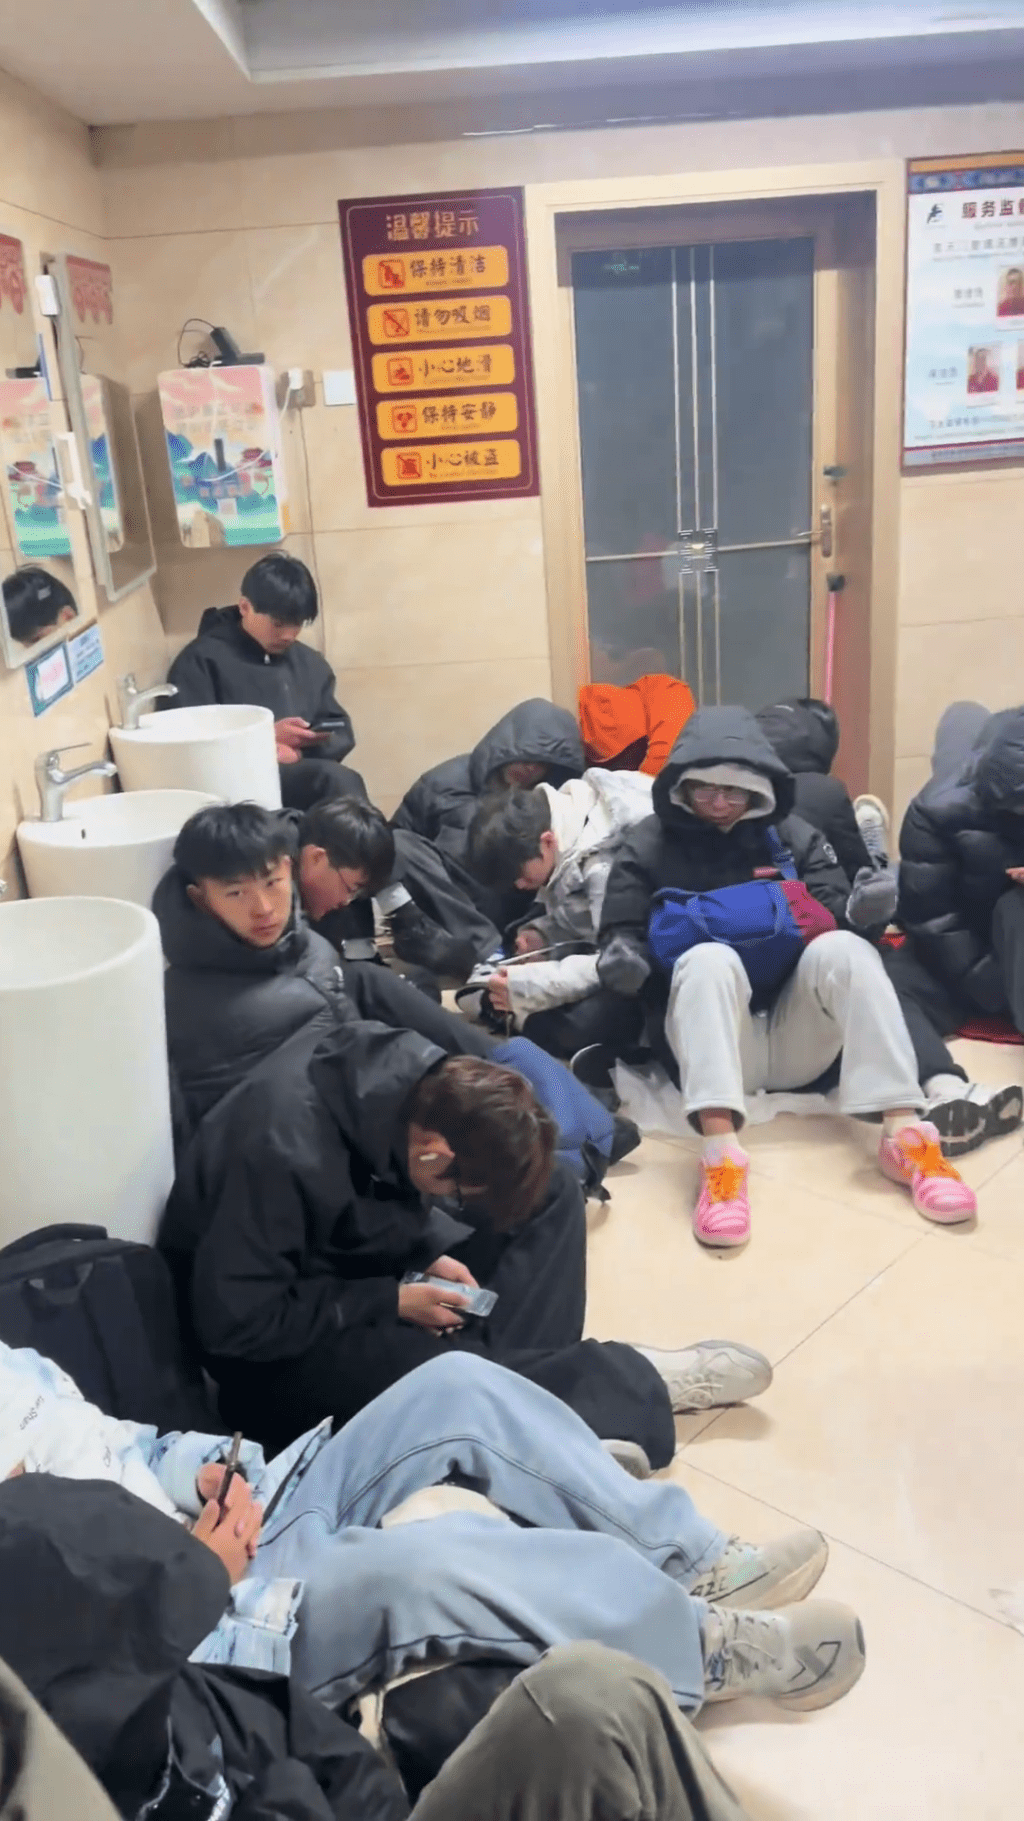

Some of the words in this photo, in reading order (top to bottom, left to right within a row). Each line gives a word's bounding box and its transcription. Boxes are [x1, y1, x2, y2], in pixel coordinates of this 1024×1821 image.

[386, 210, 479, 241] 温馨提示
[409, 254, 486, 278] 保持清洁
[414, 305, 491, 328] 请勿吸烟
[418, 353, 492, 378] 小心地滑
[422, 401, 497, 424] 保持安静
[425, 448, 499, 470] 小心被盗
